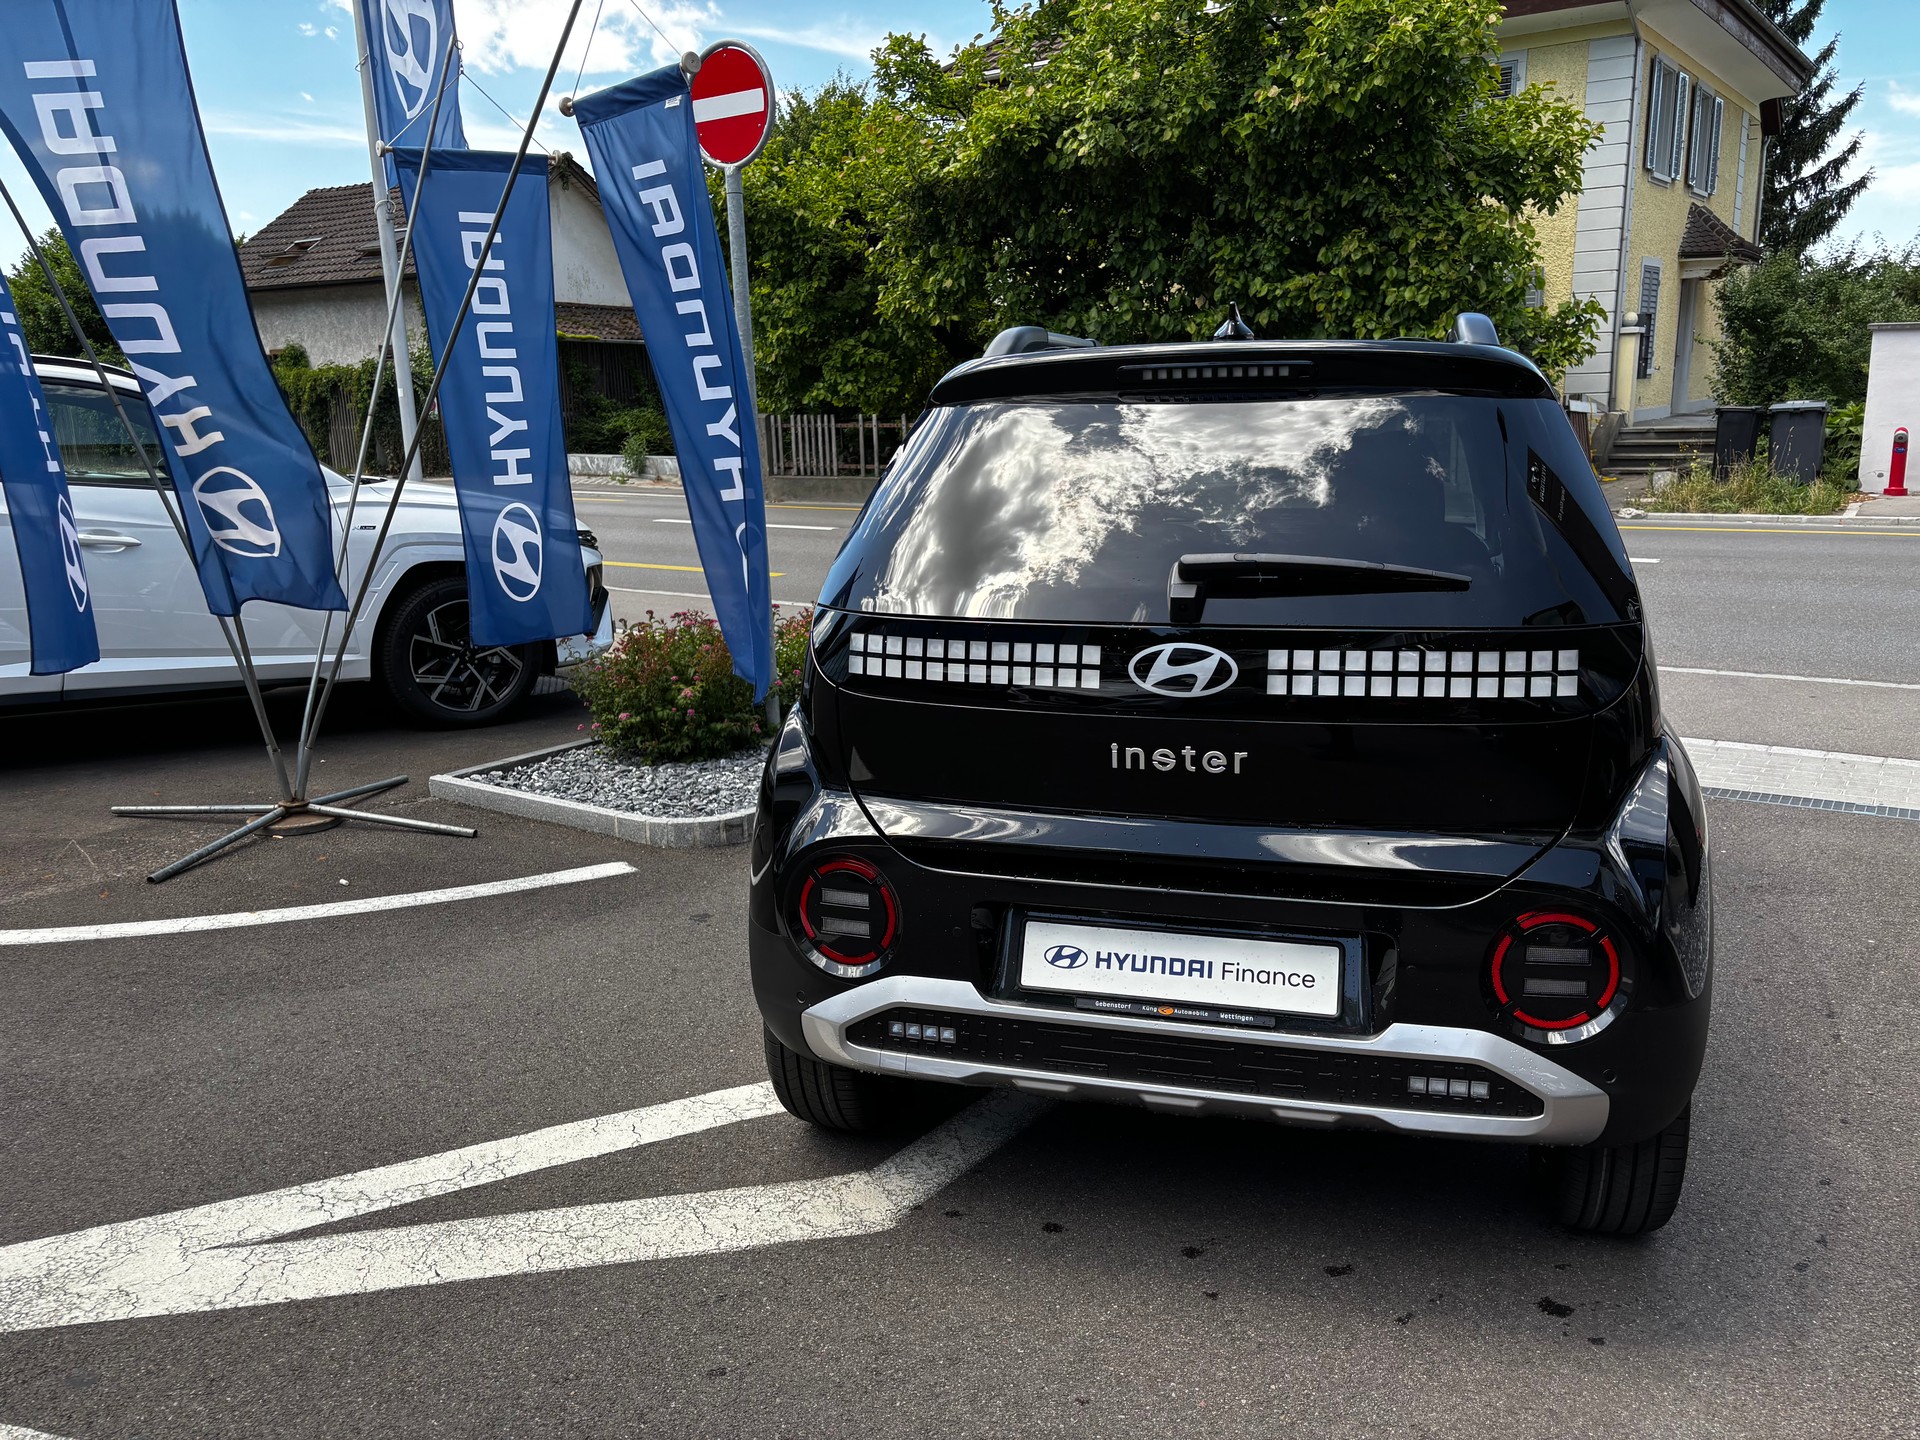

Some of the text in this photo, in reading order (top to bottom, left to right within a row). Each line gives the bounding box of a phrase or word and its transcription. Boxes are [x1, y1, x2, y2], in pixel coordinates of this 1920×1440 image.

[24, 59, 225, 457] HYUNDAI
[458, 211, 533, 486] HYUNDAI
[1110, 743, 1248, 774] inster
[1095, 951, 1316, 989] HYUNDAI Finance
[1095, 1000, 1254, 1023] Gebenstorf Küng Automobile Wettingen
